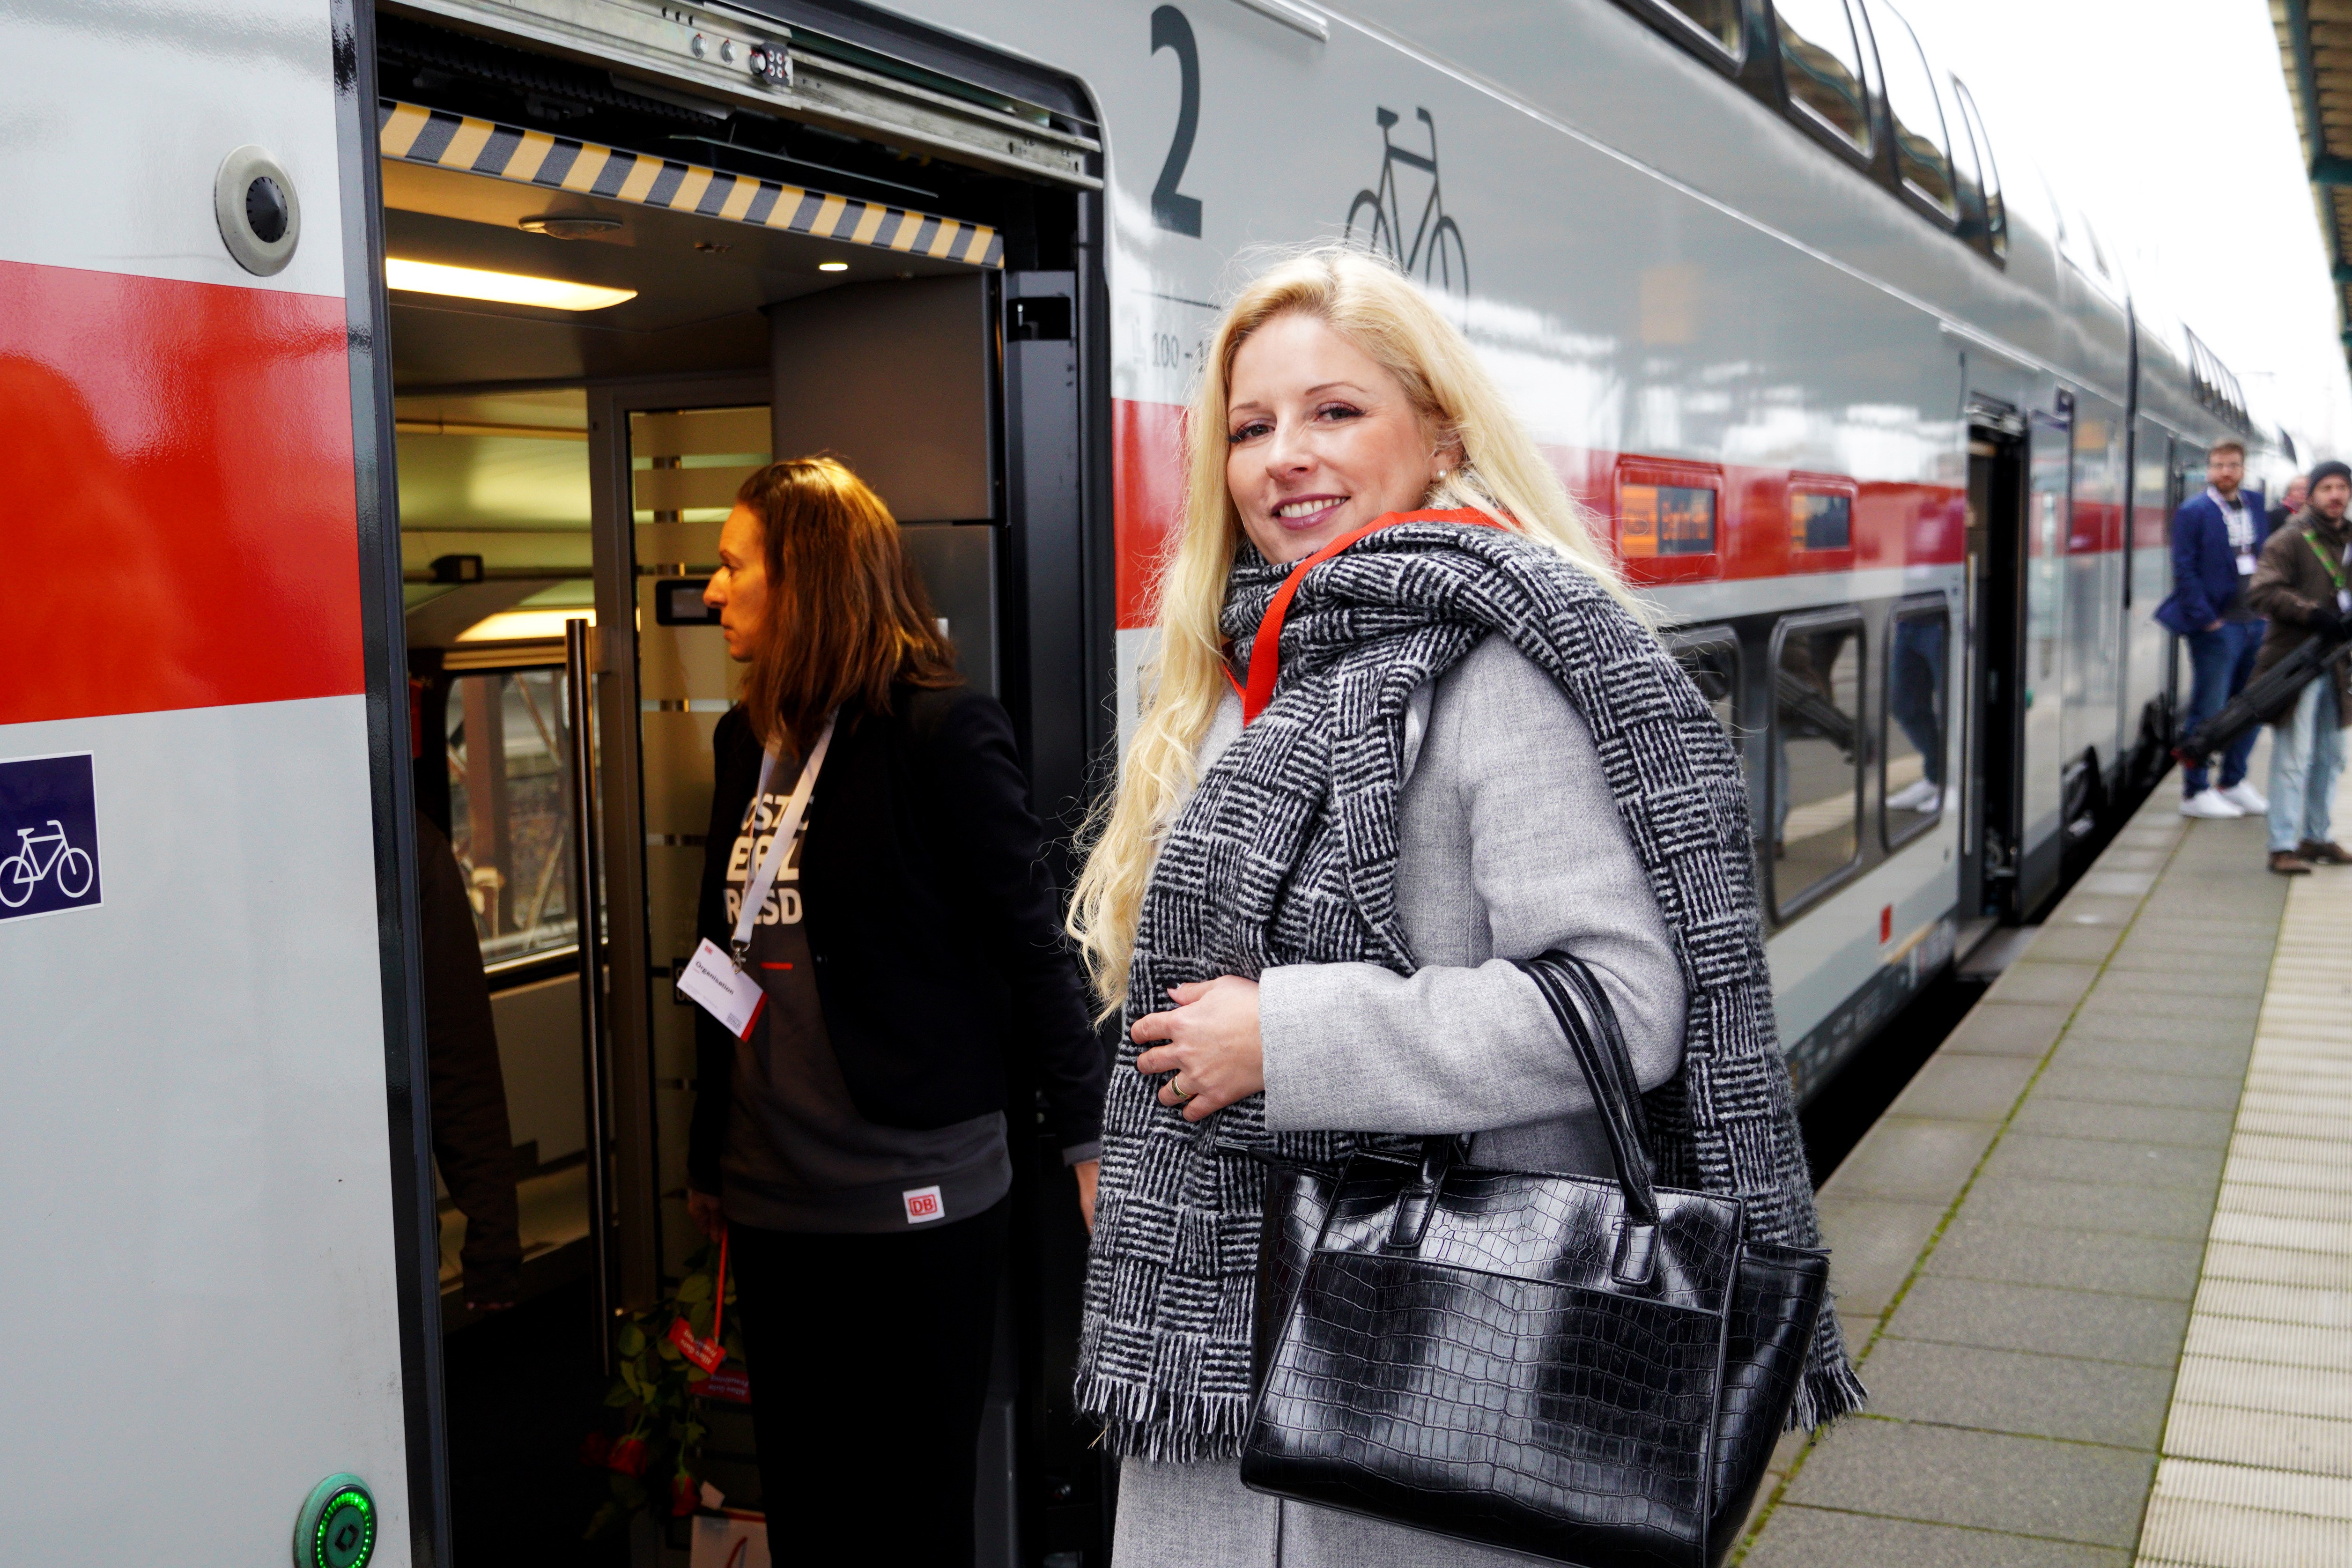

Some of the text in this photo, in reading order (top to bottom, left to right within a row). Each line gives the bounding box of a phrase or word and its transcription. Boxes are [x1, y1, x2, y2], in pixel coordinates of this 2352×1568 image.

[1151, 4, 1202, 239] 2
[1153, 332, 1180, 370] 100
[723, 887, 803, 925] RSD
[695, 961, 734, 996] Organisation
[912, 1198, 933, 1213] DB
